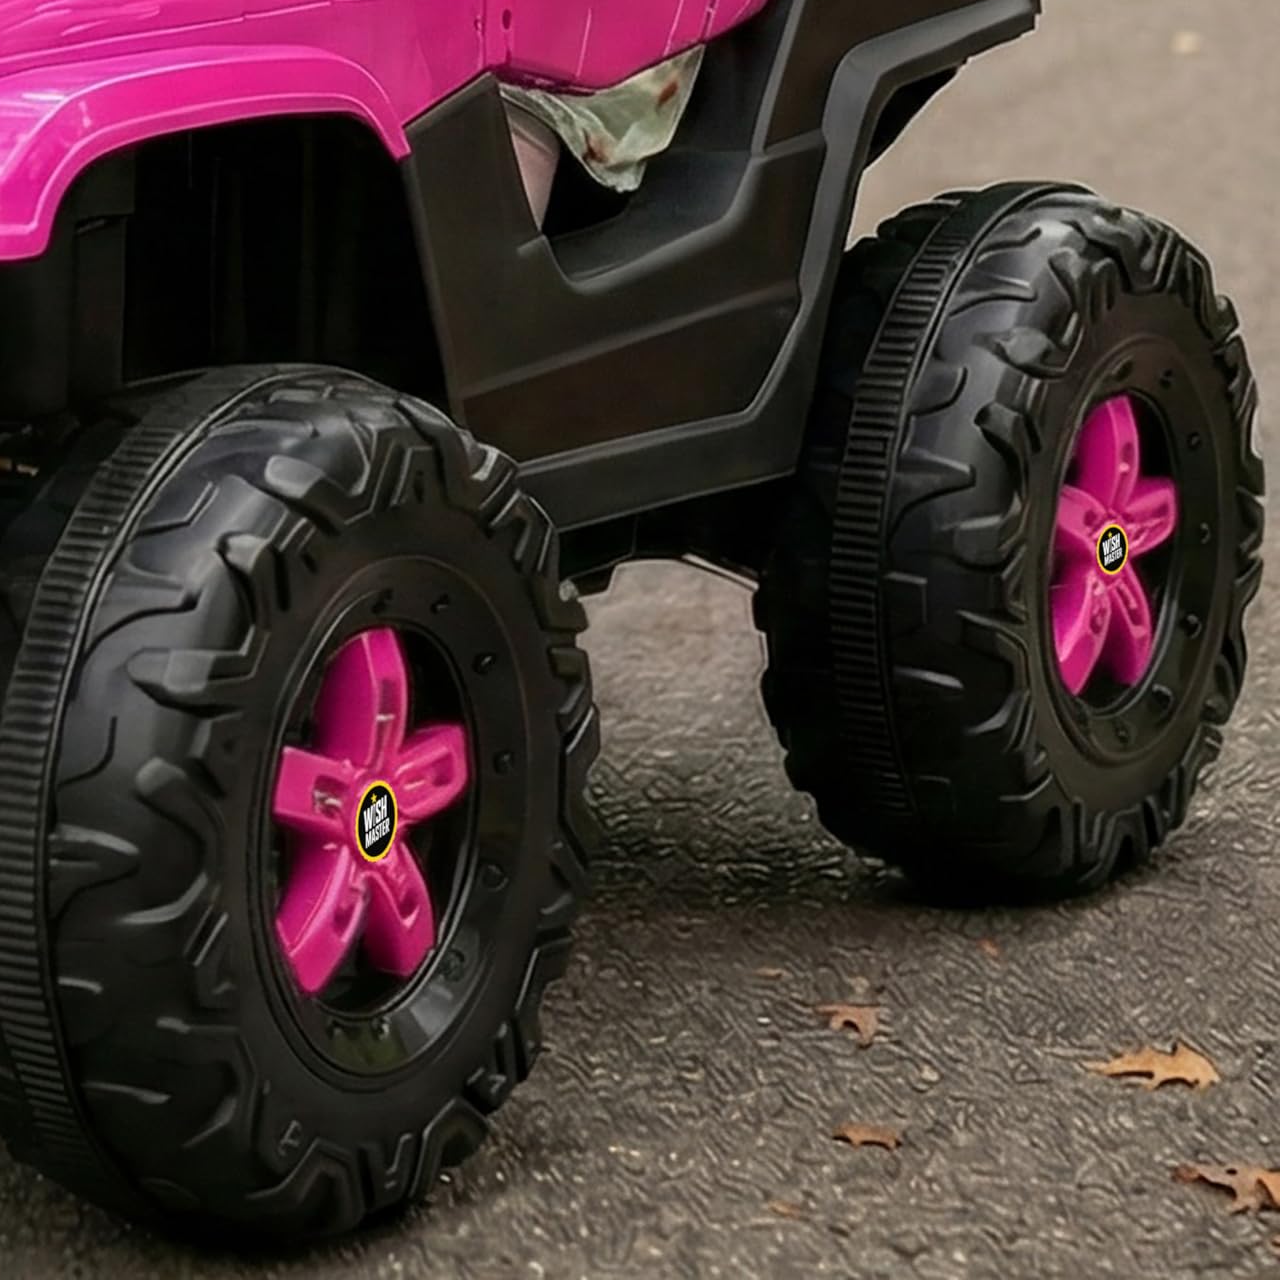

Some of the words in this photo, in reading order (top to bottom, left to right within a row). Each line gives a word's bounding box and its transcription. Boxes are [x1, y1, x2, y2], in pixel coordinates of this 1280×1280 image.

[1102, 532, 1121, 556] WISH
[1104, 547, 1123, 566] MASTER
[363, 794, 388, 832] WISH
[365, 817, 390, 849] MASTER
